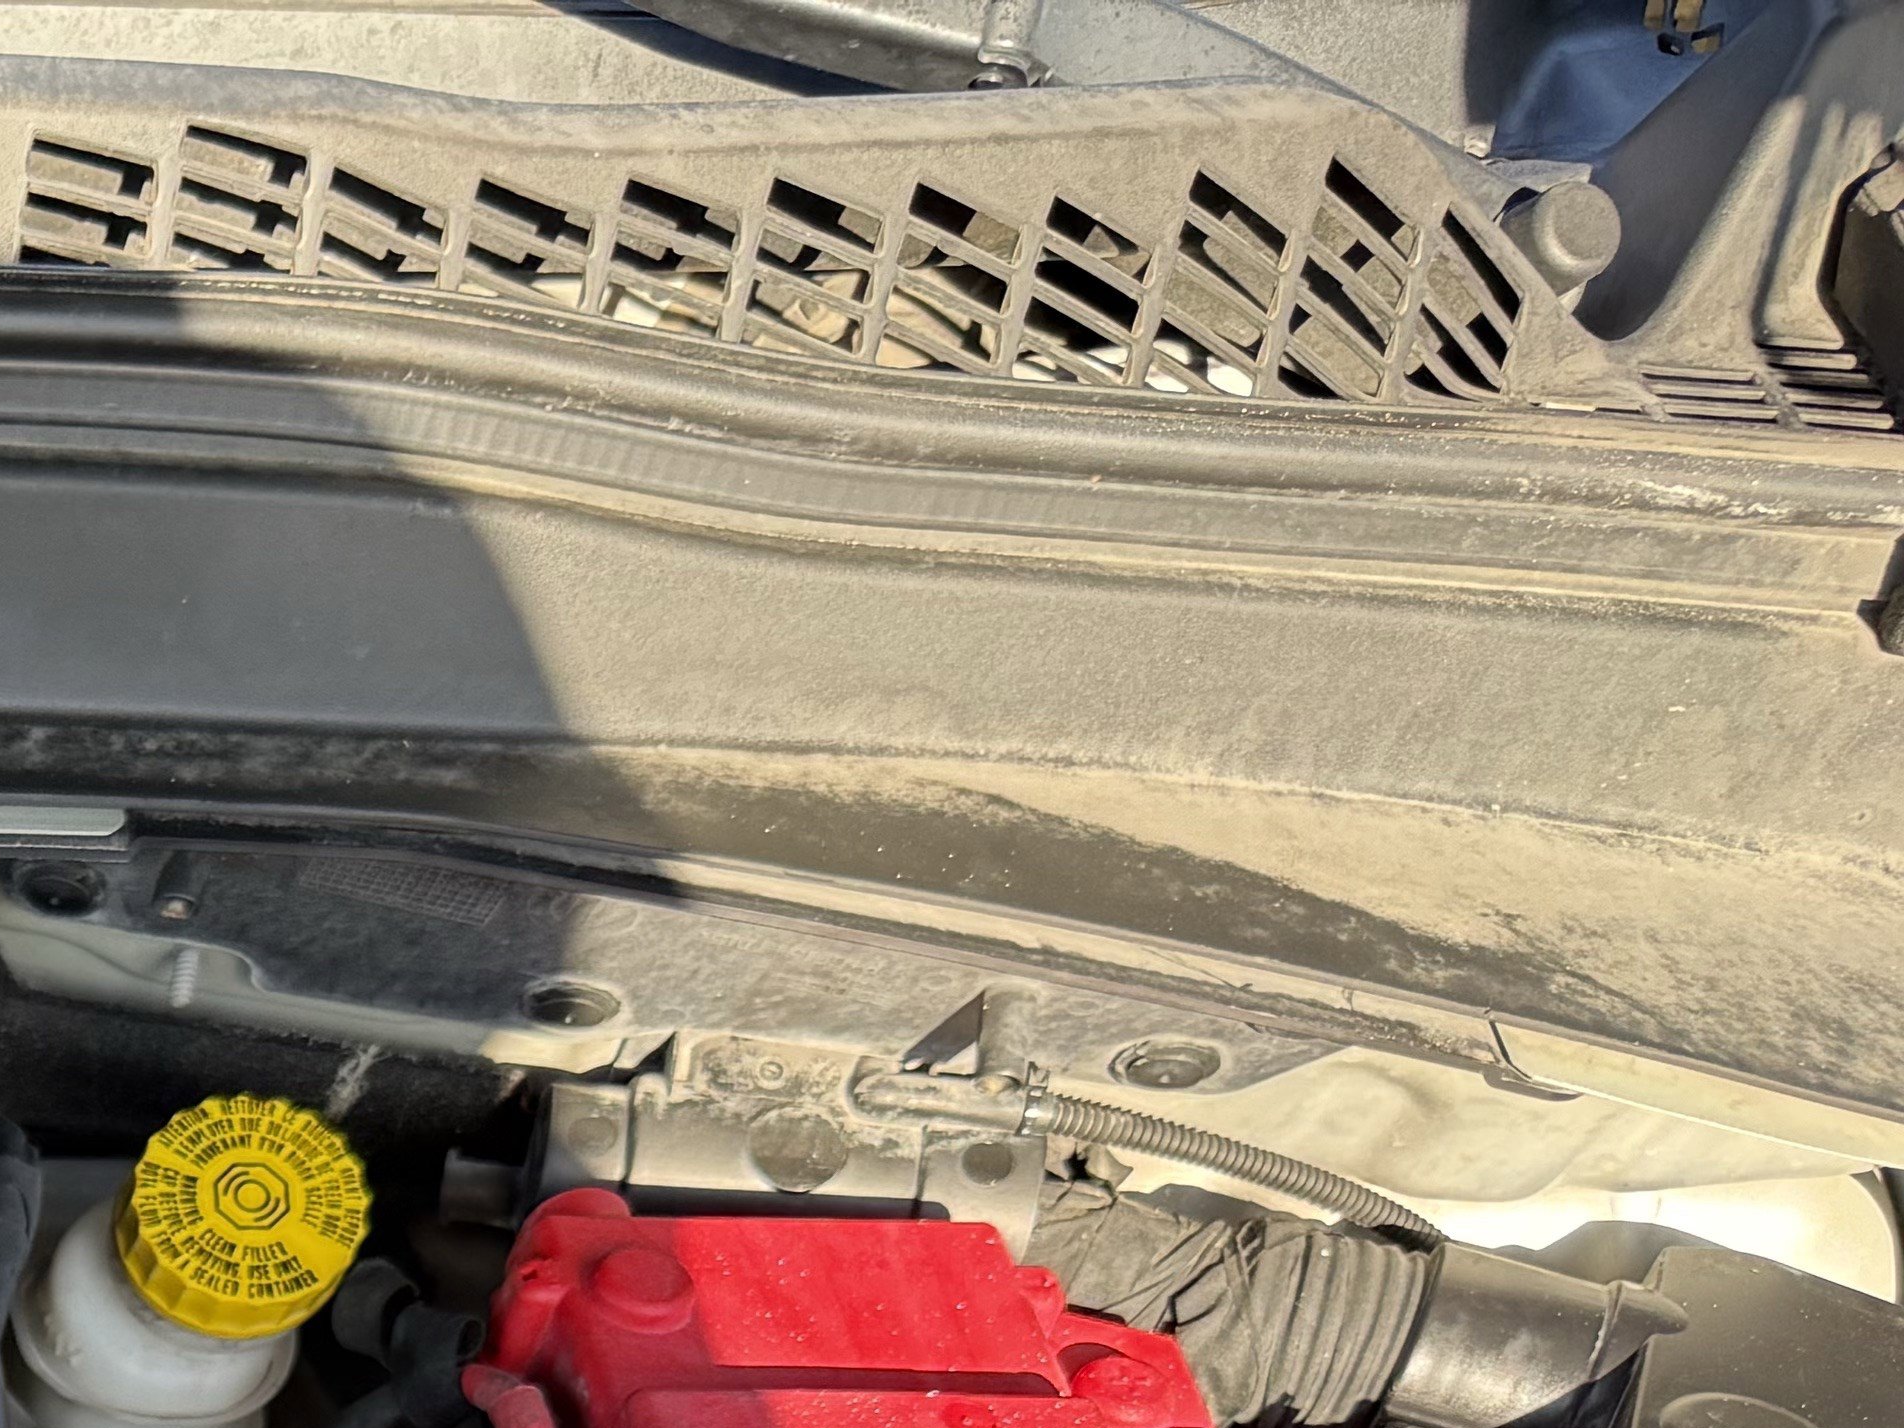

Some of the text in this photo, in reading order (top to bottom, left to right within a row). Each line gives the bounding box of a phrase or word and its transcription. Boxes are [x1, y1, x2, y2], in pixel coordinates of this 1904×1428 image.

[199, 1228, 237, 1257] CLEAN
[242, 1240, 288, 1262] FILLER
[189, 1266, 240, 1297] SEALED
[247, 1269, 319, 1300] CONTAINER
[247, 1264, 269, 1280] USE
